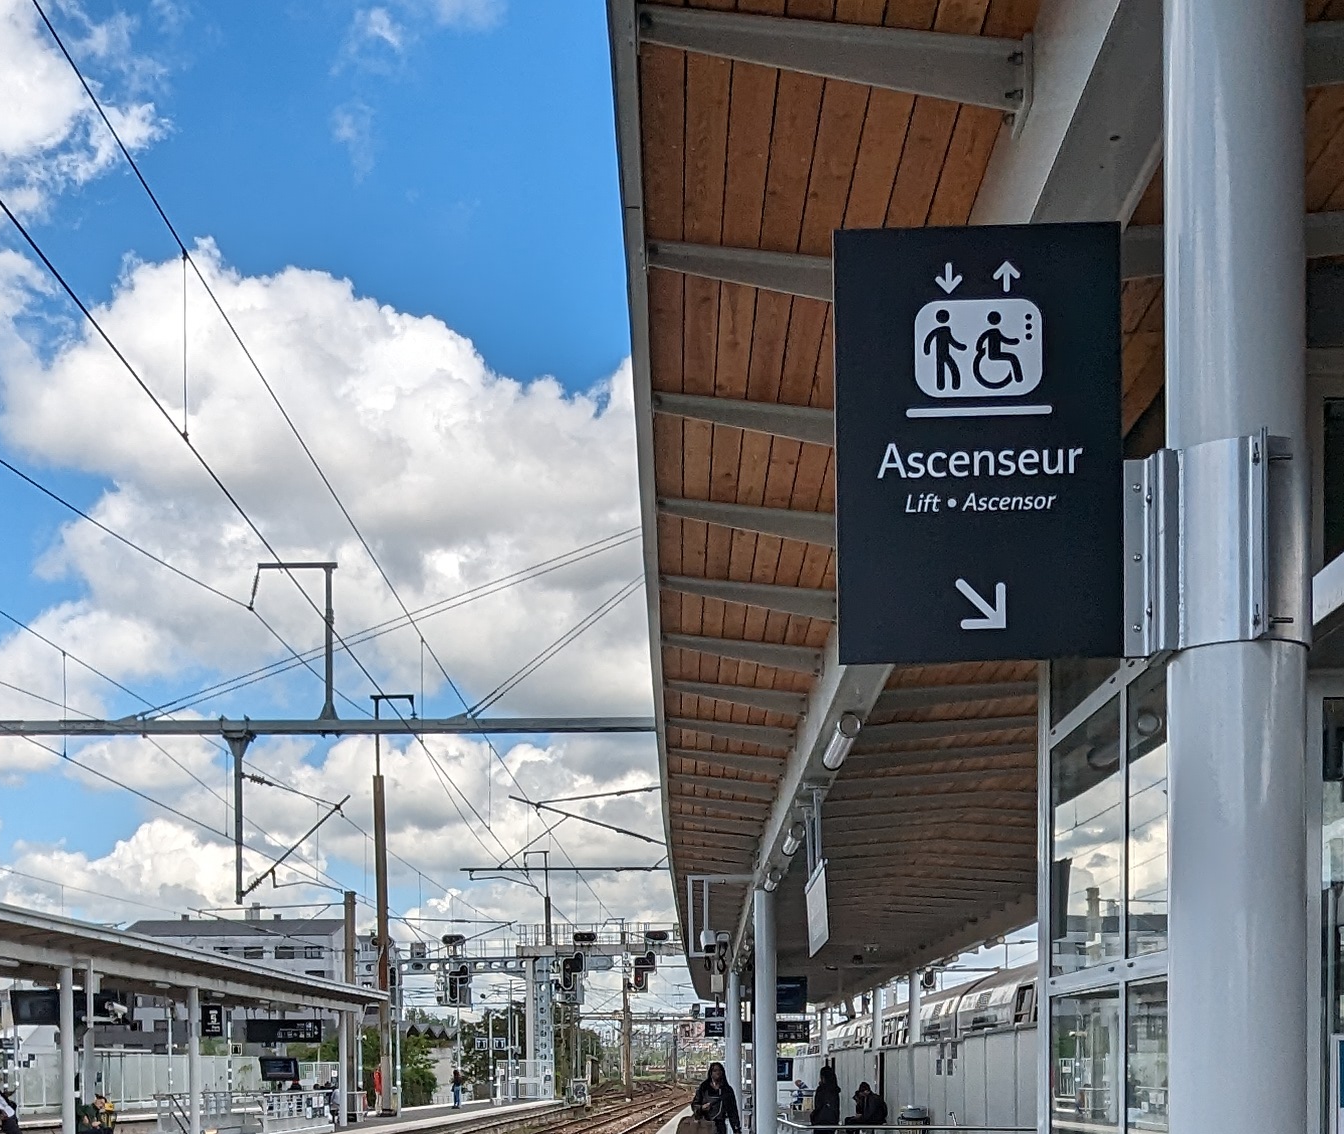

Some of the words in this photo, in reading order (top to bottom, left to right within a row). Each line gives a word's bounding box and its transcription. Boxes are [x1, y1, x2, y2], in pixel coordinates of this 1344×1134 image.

[876, 442, 1084, 479] Ascenseur
[905, 492, 941, 514] Lift
[962, 492, 1057, 512] Ascensor
